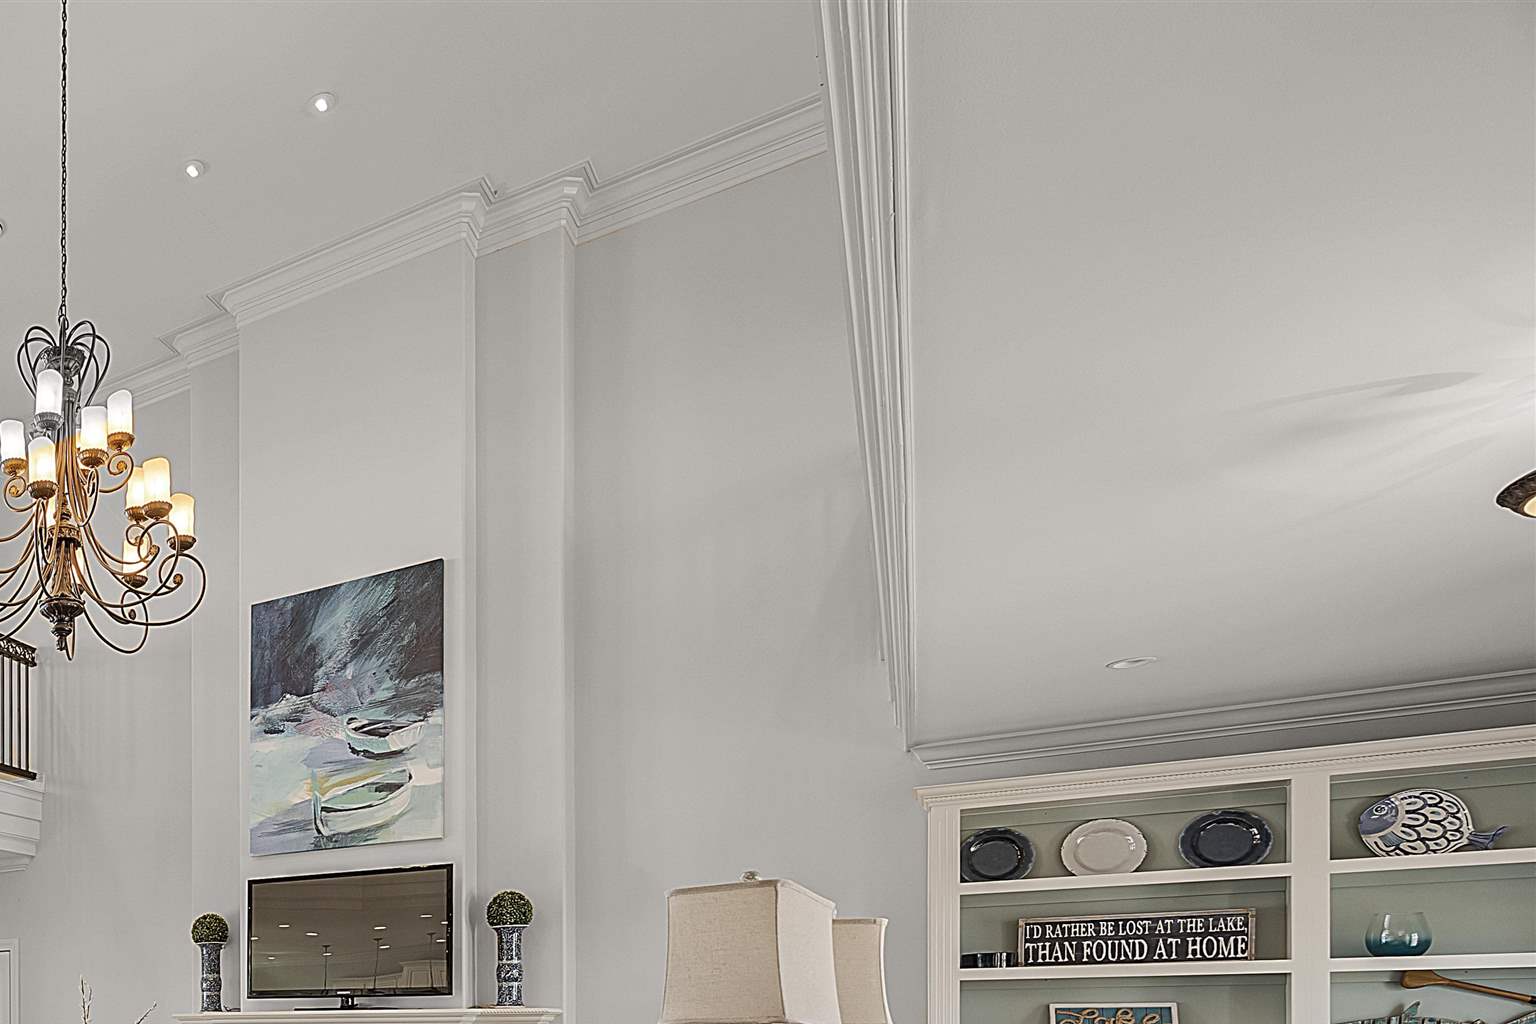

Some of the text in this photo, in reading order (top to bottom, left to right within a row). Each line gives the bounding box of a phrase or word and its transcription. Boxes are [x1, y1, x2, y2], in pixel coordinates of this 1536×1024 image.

[1025, 916, 1248, 939] I'D RATHER BE LOST AT THE LAKE,
[1025, 935, 1248, 964] THAN FOUND AT HOME
